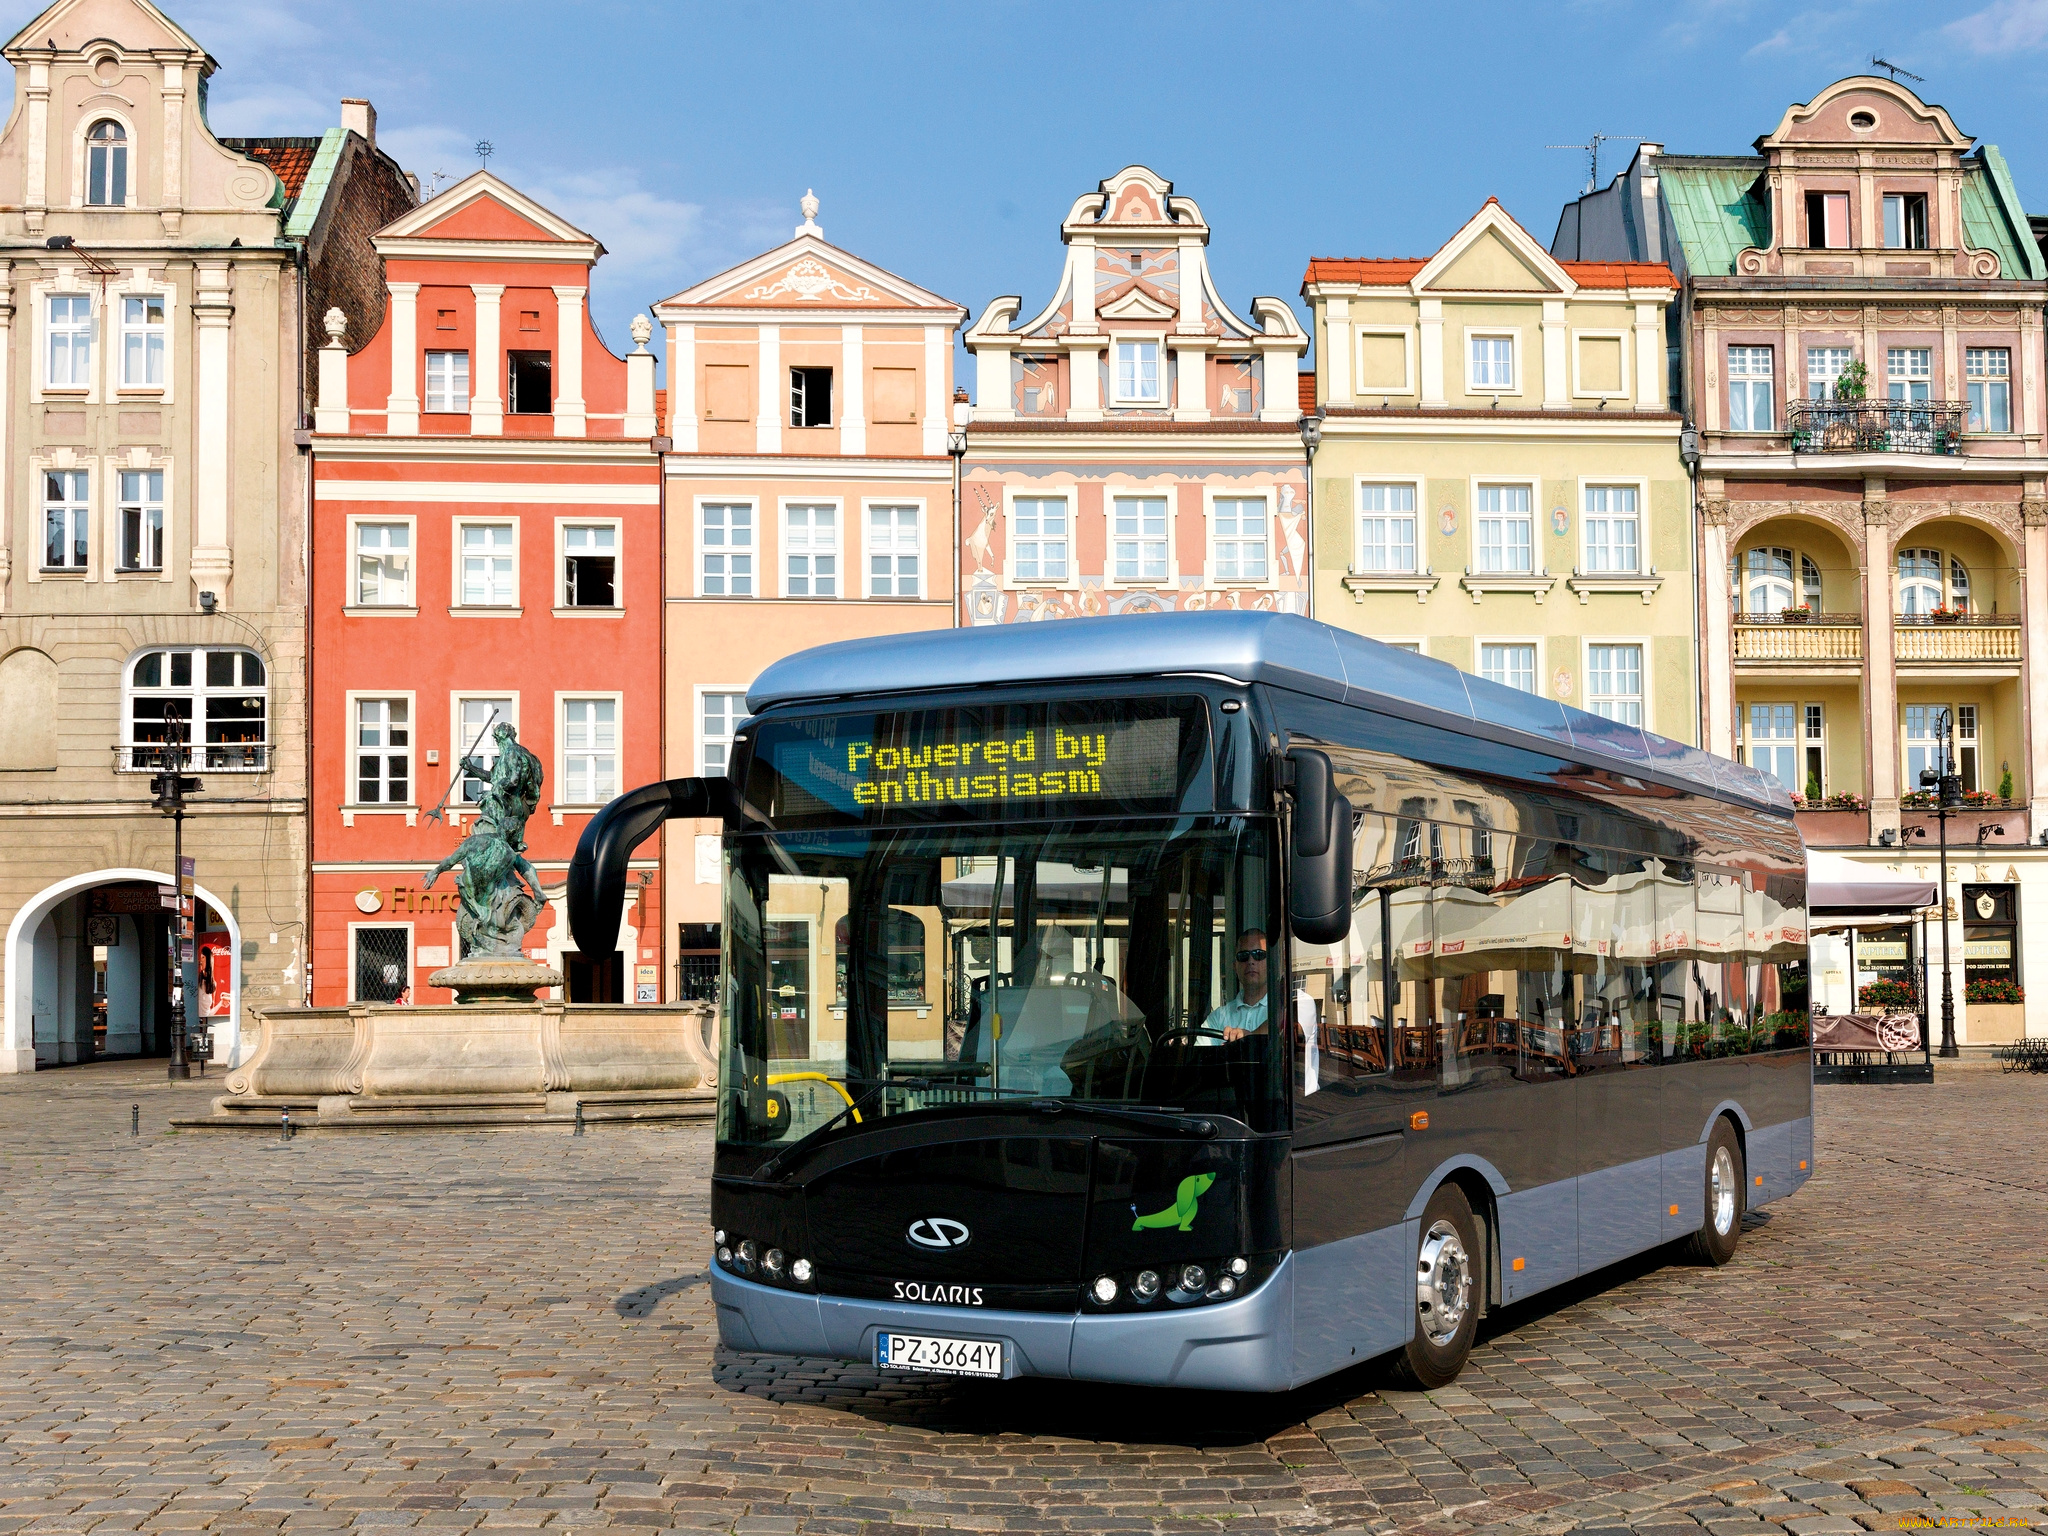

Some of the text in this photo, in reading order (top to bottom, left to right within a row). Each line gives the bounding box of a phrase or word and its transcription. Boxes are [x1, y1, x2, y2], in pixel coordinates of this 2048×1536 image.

[847, 730, 1036, 772] Powered
[1055, 728, 1106, 767] by
[853, 766, 1101, 804] enthusiasm
[1859, 946, 1904, 956] APTEKA
[1964, 945, 2009, 956] APTEKA
[893, 1281, 983, 1306] SOLARIS
[880, 1337, 997, 1370] PL PZ 3664Y
